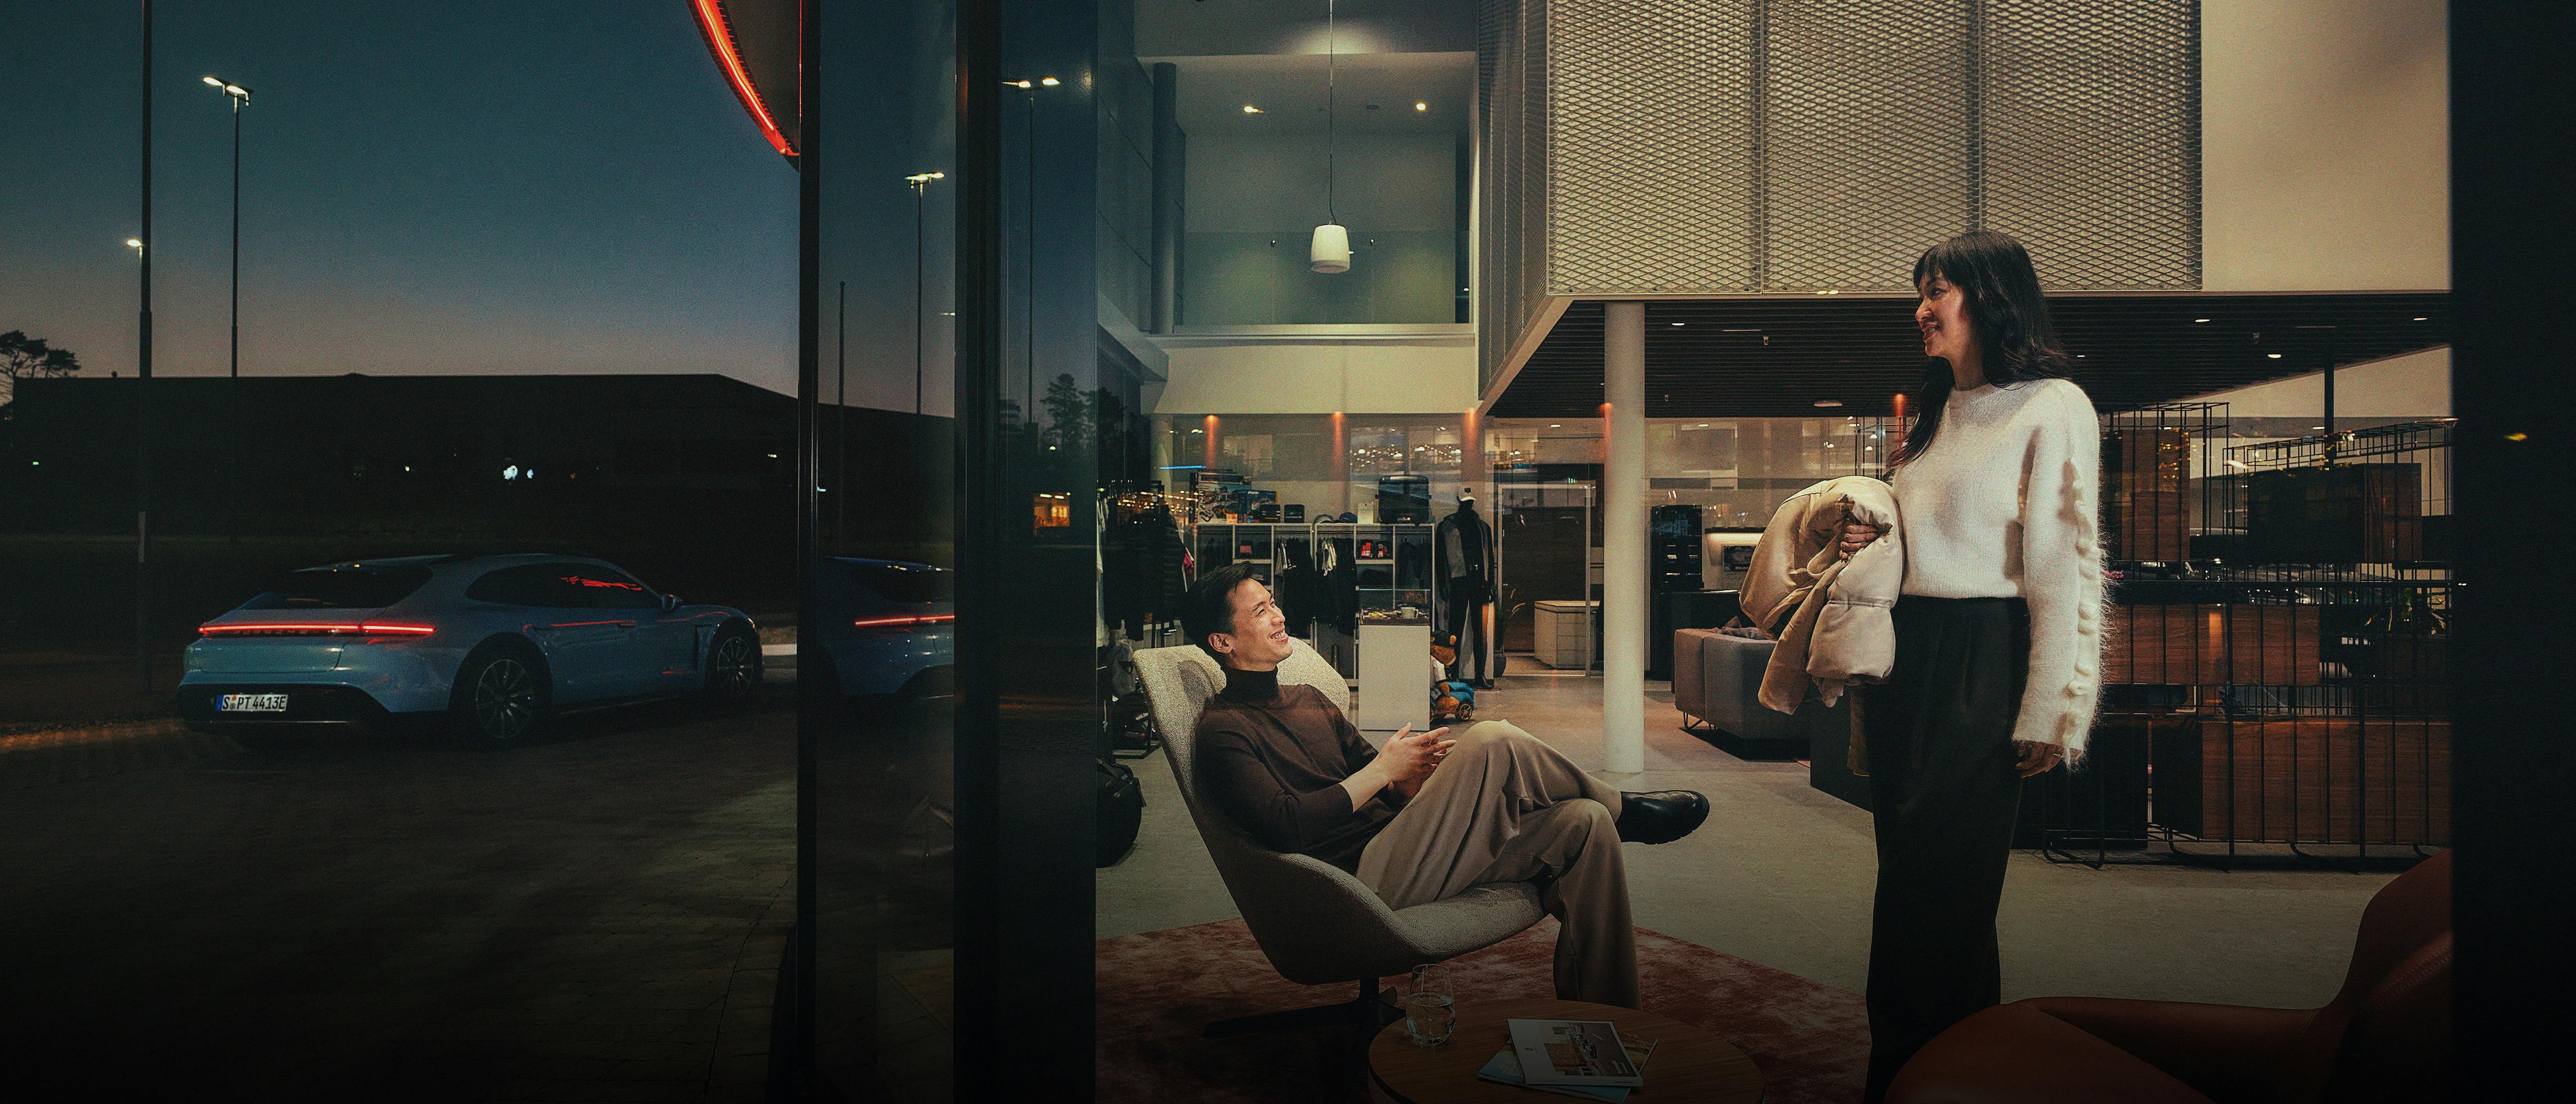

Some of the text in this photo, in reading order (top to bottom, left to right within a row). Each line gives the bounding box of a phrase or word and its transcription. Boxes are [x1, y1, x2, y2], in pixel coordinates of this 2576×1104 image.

[222, 696, 286, 709] S PT 4413E
